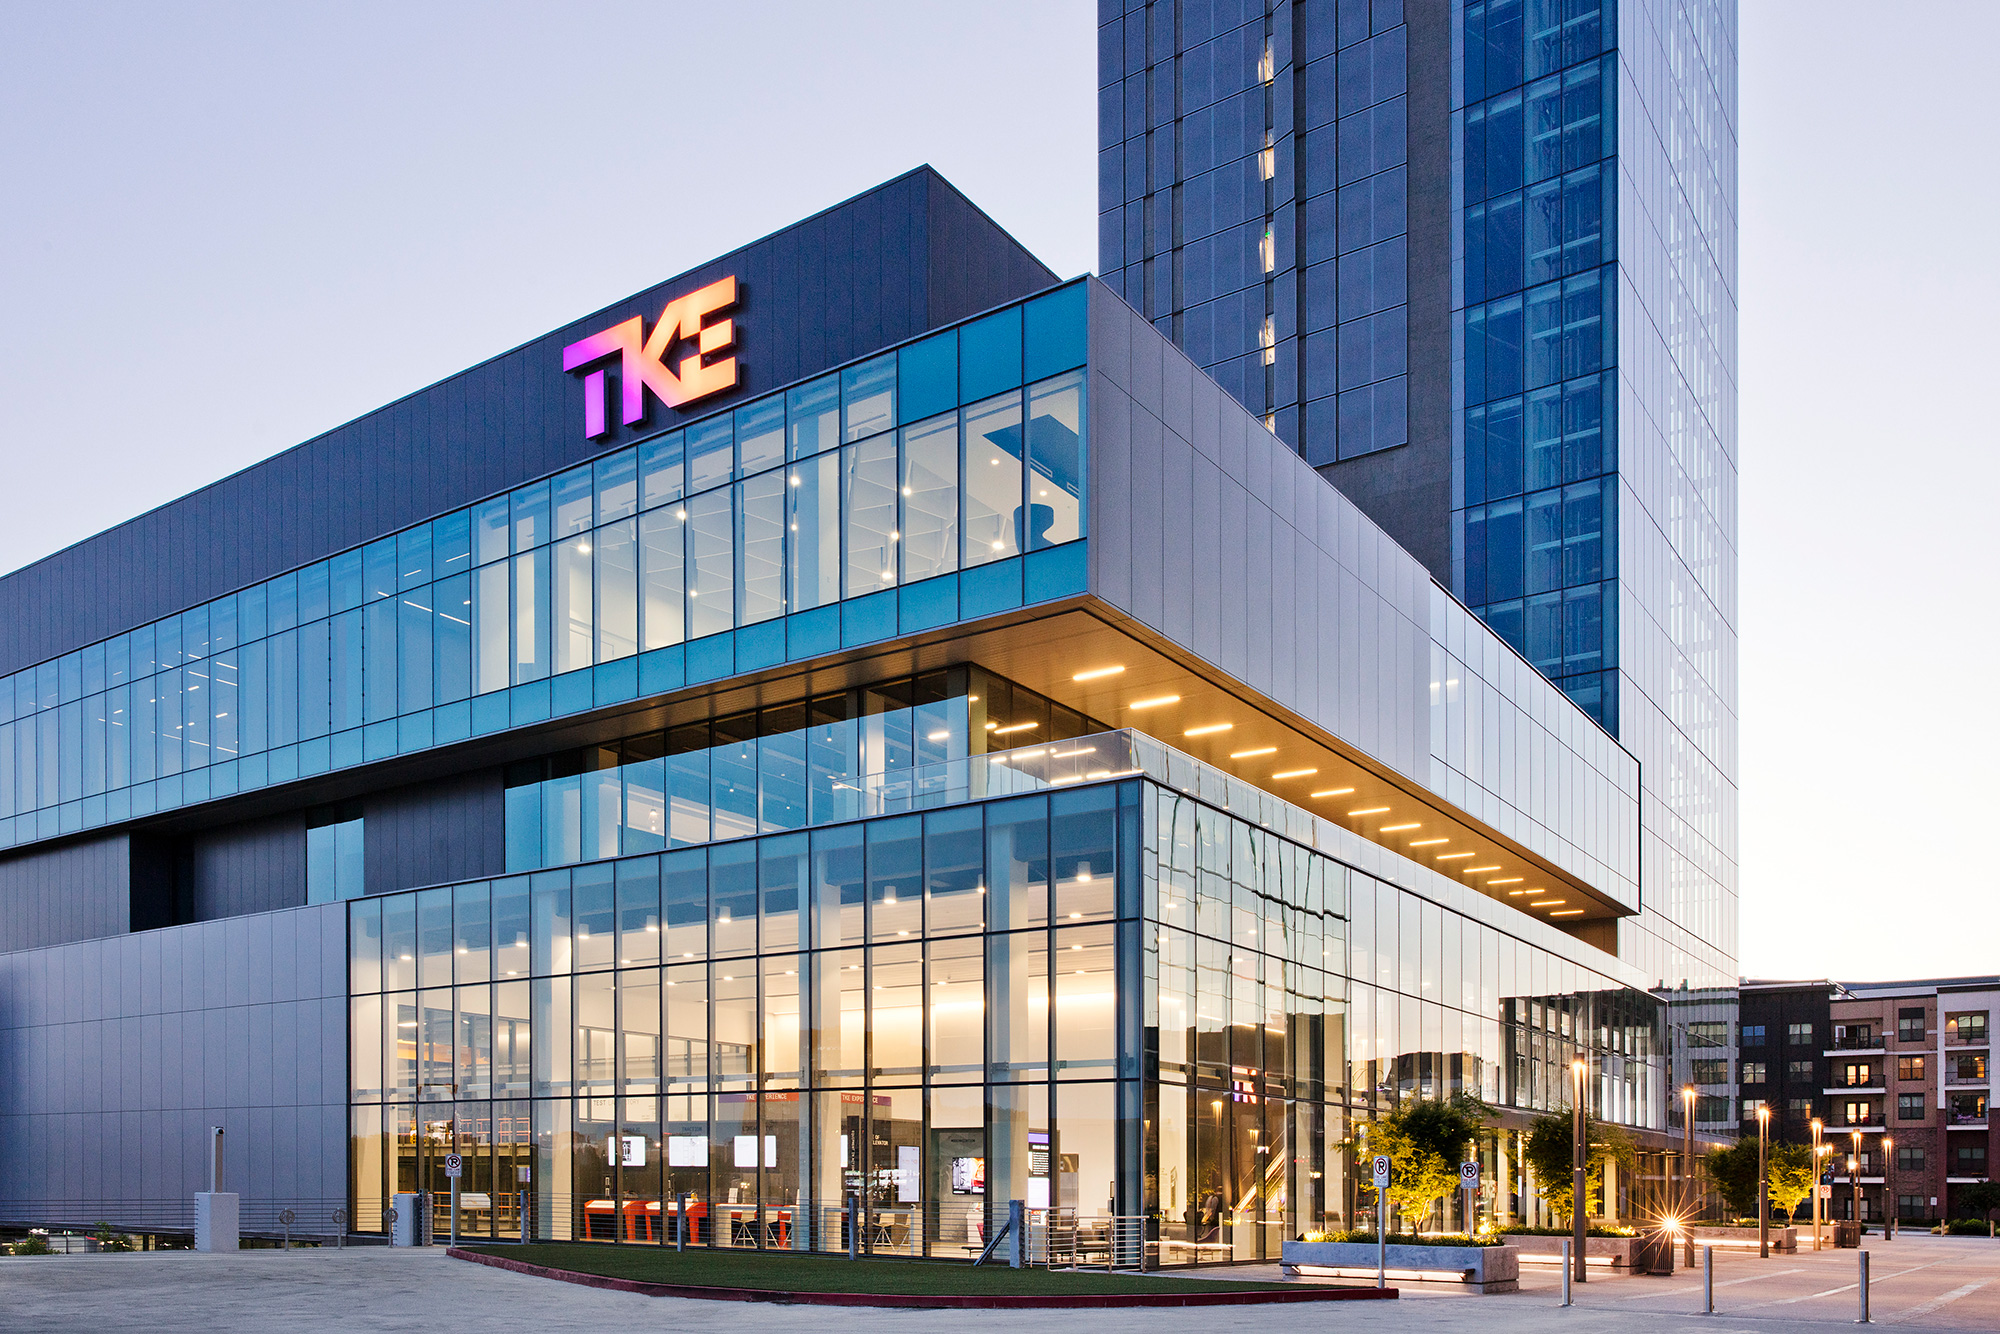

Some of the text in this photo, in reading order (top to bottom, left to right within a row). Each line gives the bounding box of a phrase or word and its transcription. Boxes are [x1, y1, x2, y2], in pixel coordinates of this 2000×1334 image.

[562, 274, 739, 440] TKE
[746, 1092, 788, 1101] TKE ERIENCE
[842, 1094, 879, 1104] TKE EXPECE
[593, 1099, 606, 1107] TEST
